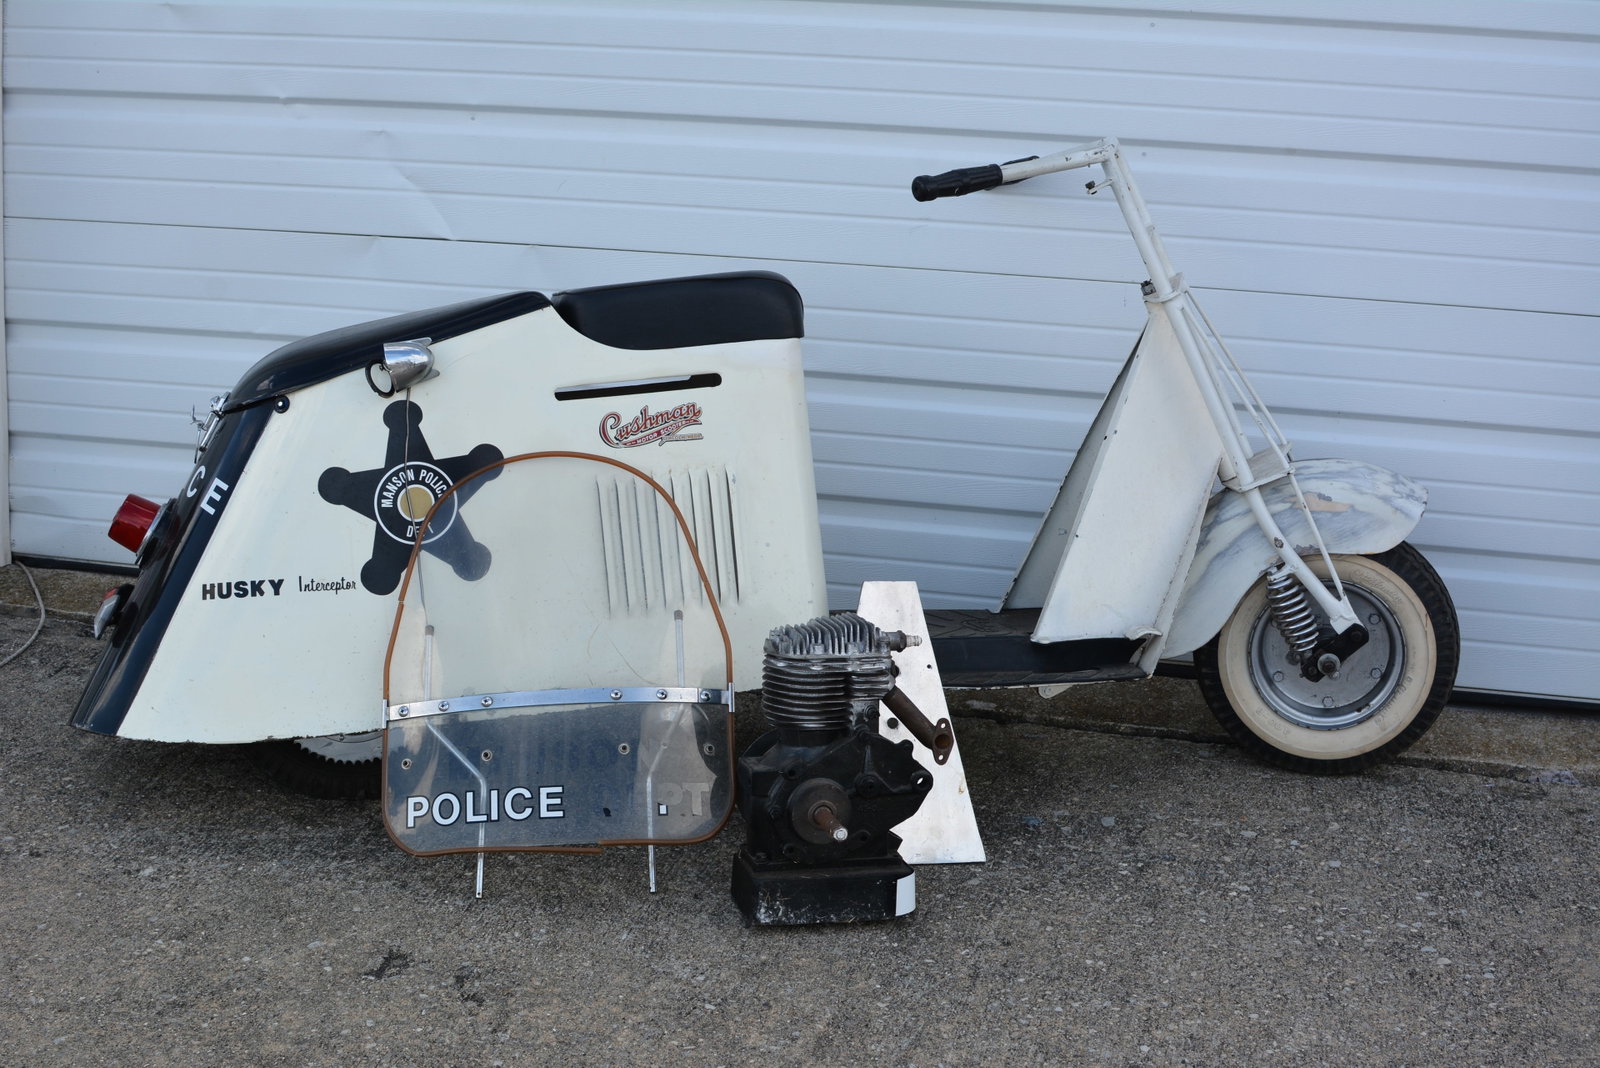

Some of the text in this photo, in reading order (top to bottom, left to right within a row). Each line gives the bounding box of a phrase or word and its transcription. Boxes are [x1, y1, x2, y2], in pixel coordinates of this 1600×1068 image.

[599, 402, 703, 449] Cushman
[381, 469, 448, 508] MANSON POLIC
[202, 576, 356, 601] HUSKY Interceptor
[406, 785, 565, 829] POLICE
